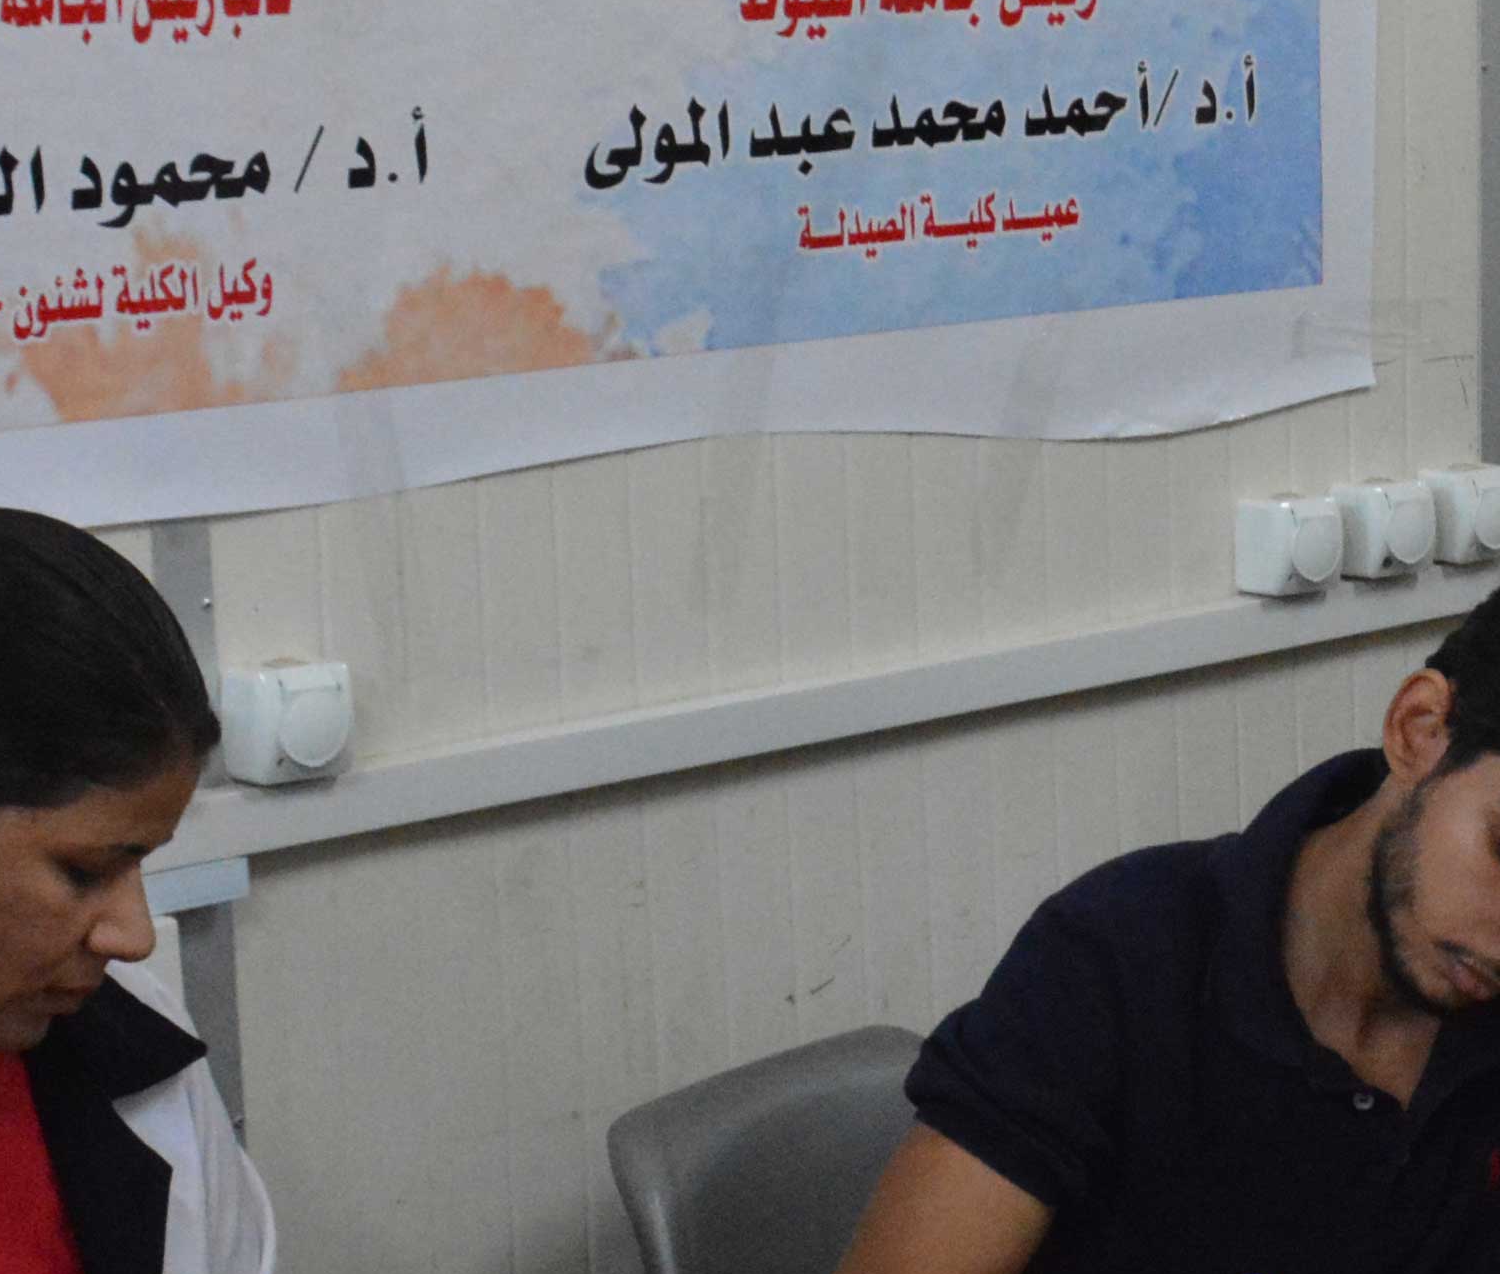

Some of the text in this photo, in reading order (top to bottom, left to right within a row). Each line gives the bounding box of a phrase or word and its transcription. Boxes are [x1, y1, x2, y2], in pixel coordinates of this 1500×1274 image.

[585, 99, 729, 189] المولى
[750, 105, 855, 174] عبد
[873, 97, 1005, 147] محمد
[72, 152, 270, 227] محمود
[799, 196, 1079, 257] عميد كلية الصيدلة
[14, 269, 104, 347] لشئون
[113, 266, 198, 329] الكلية
[208, 259, 273, 320] وكيل
